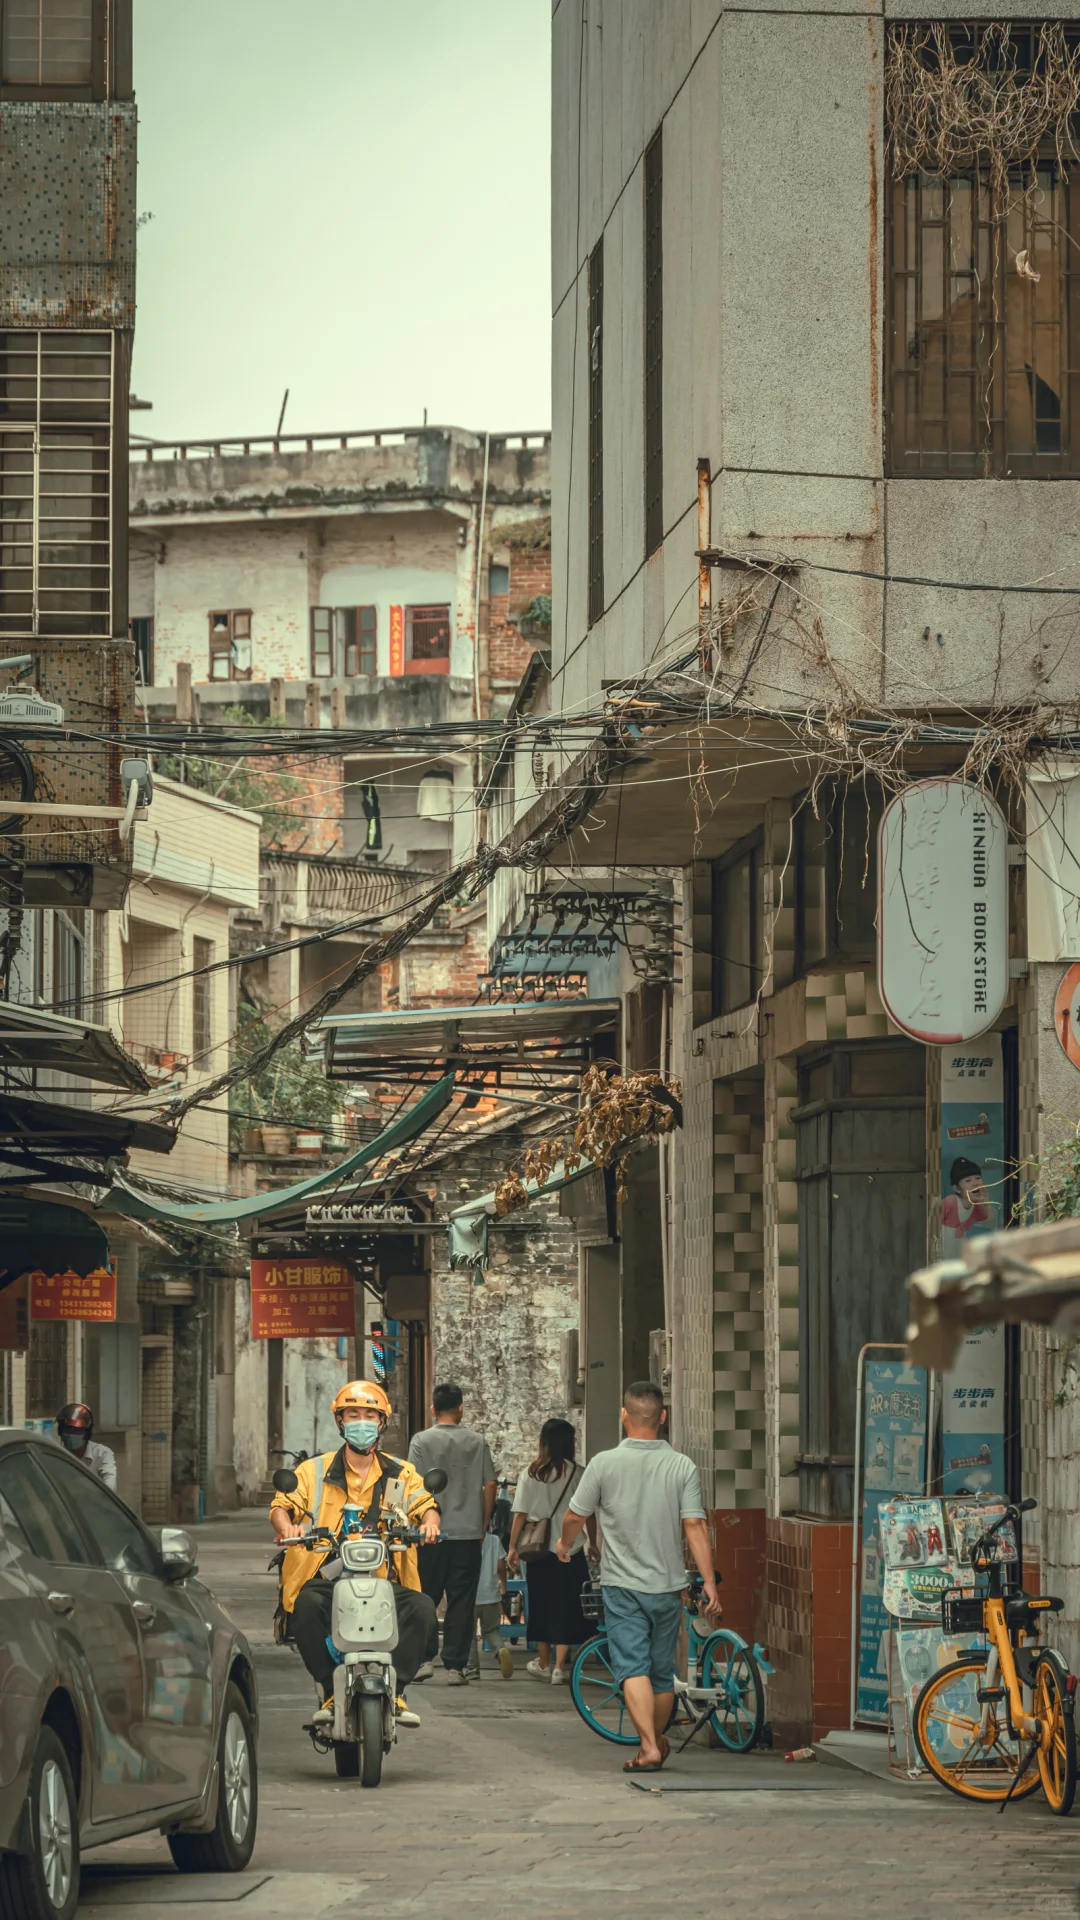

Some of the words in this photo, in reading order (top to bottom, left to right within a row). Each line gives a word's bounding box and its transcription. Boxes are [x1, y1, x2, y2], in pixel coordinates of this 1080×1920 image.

[972, 812, 986, 888] XINHUA
[973, 902, 987, 1014] BOOKSTORE
[951, 1057, 994, 1068] 步步高
[957, 1069, 986, 1077] 点读机
[265, 1266, 341, 1286] 小甘服饰
[952, 1387, 996, 1399] 步步高
[958, 1400, 988, 1408] 点读机
[910, 1574, 949, 1588] 3000
